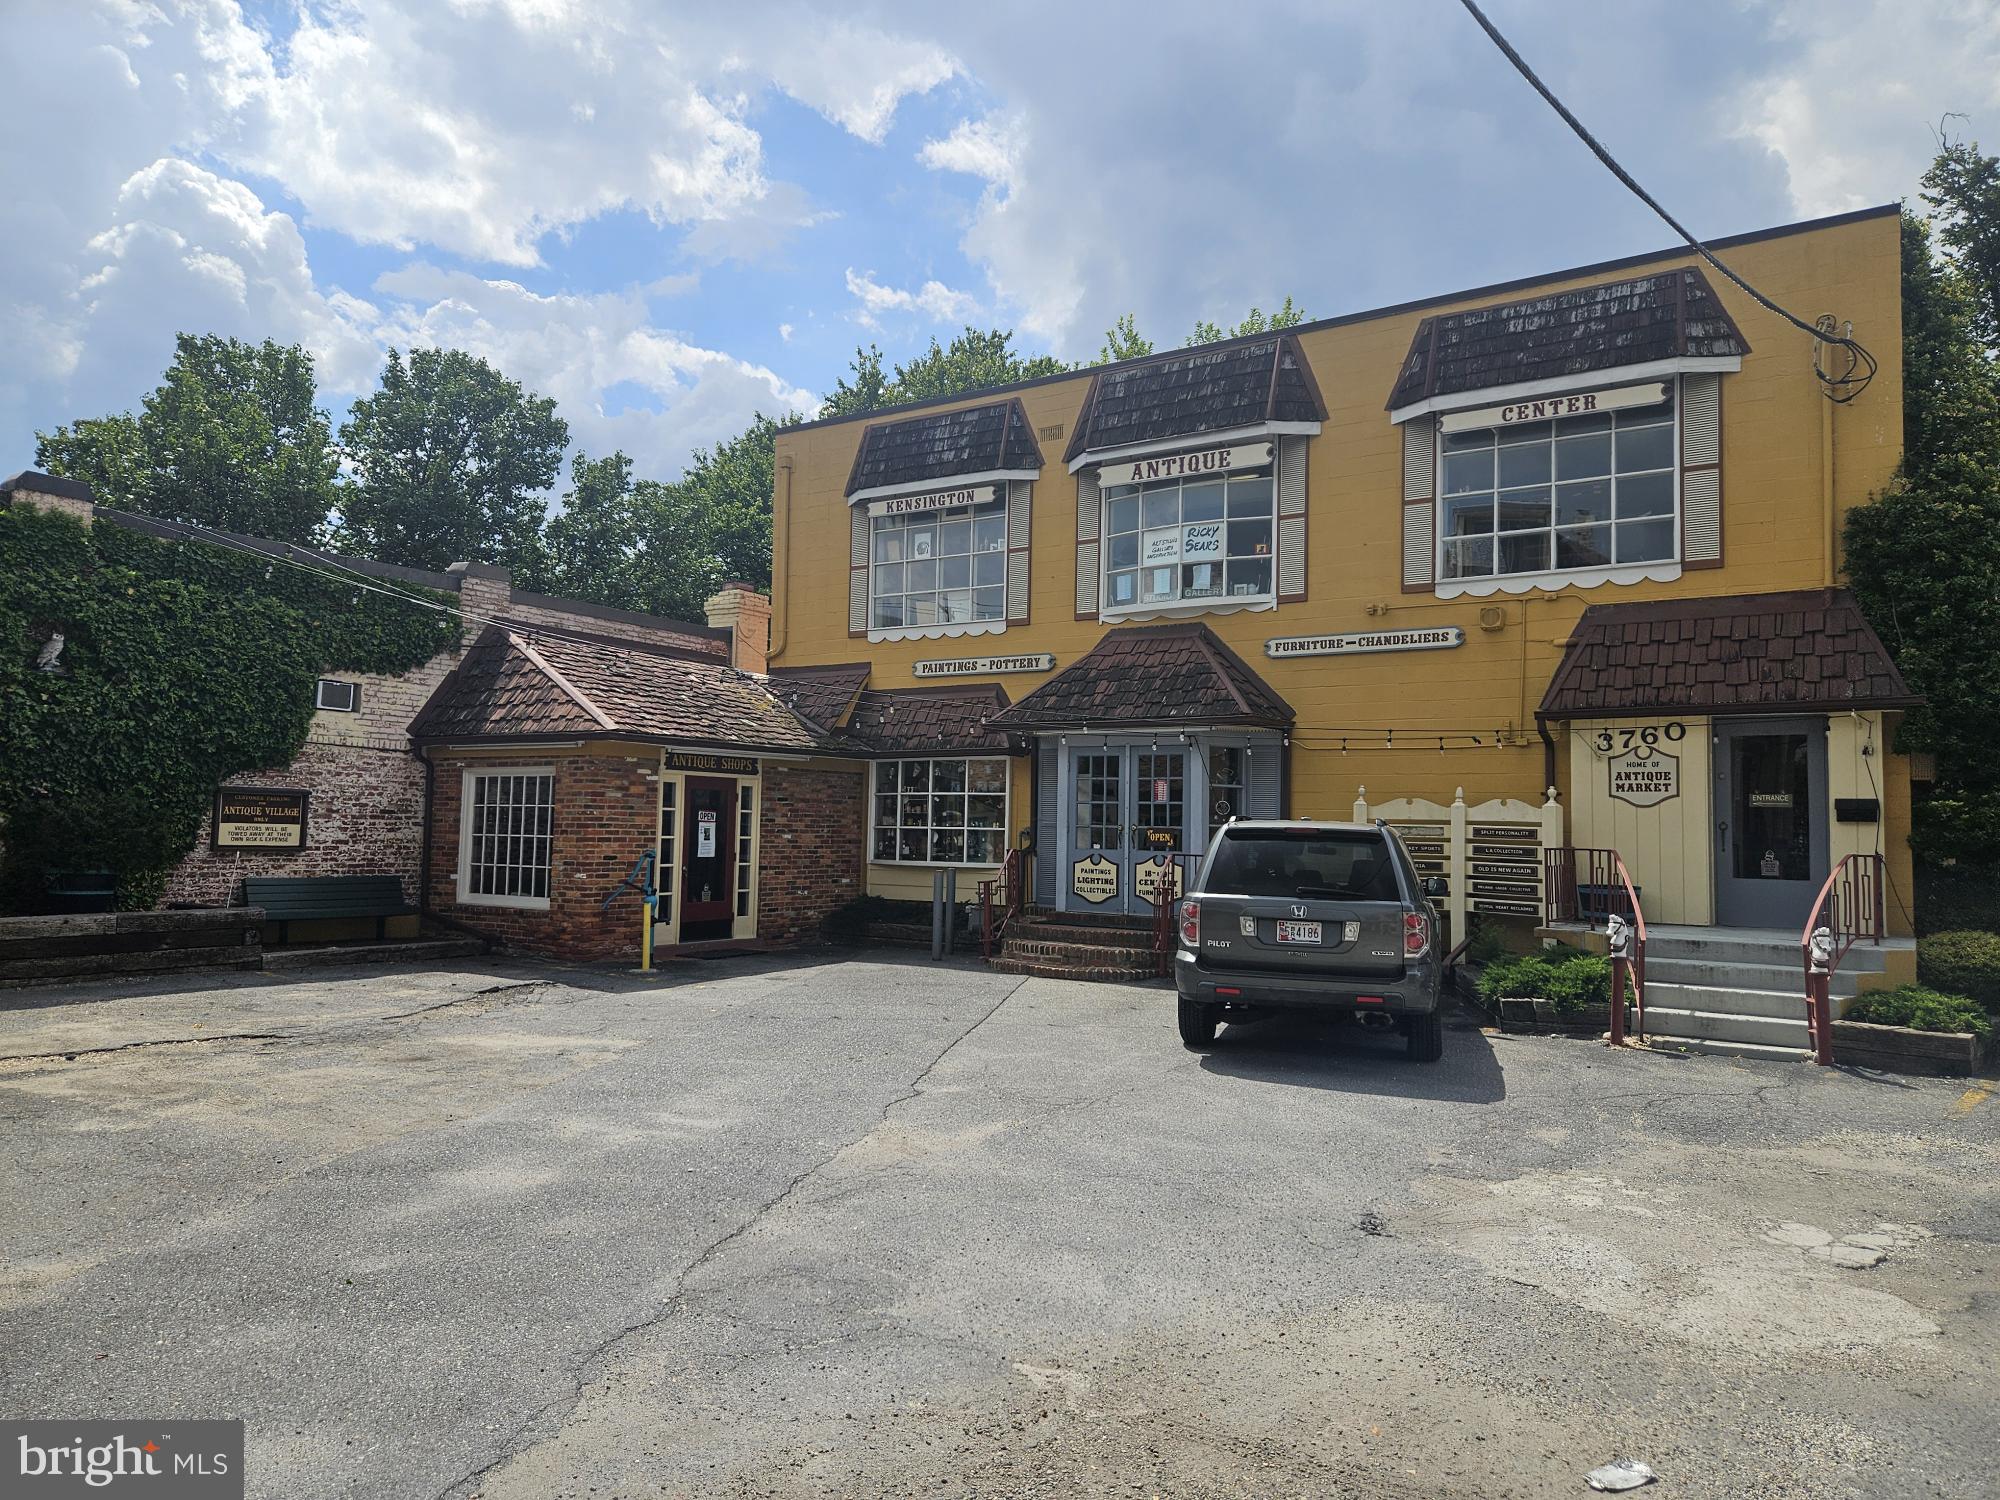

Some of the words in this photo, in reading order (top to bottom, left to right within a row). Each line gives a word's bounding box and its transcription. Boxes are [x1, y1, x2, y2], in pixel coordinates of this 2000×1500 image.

[1502, 394, 1597, 422] CENTER
[1131, 449, 1231, 480] ANTIQUE
[886, 489, 975, 513] KENSINGTON
[1185, 540, 1219, 553] SEARS
[1184, 587, 1223, 597] GALLERY
[1275, 638, 1344, 652] FURNITURE
[1358, 632, 1450, 647] CHANDELIERS
[922, 660, 978, 674] PAINTINGS
[990, 657, 1040, 670] POTTERY
[1597, 722, 1686, 752] 3760
[672, 754, 717, 769] ANTIQUE
[721, 758, 753, 771] SHOPS
[1614, 771, 1672, 782] ANTIQUE
[1616, 782, 1672, 792] MARKET
[224, 806, 262, 816] ANTIQUE
[265, 807, 300, 816] VILLAGE
[699, 812, 715, 820] OPEN
[1150, 832, 1170, 841] OPEN
[1077, 876, 1114, 886] LIGHTING
[1208, 940, 1231, 948] PILOT
